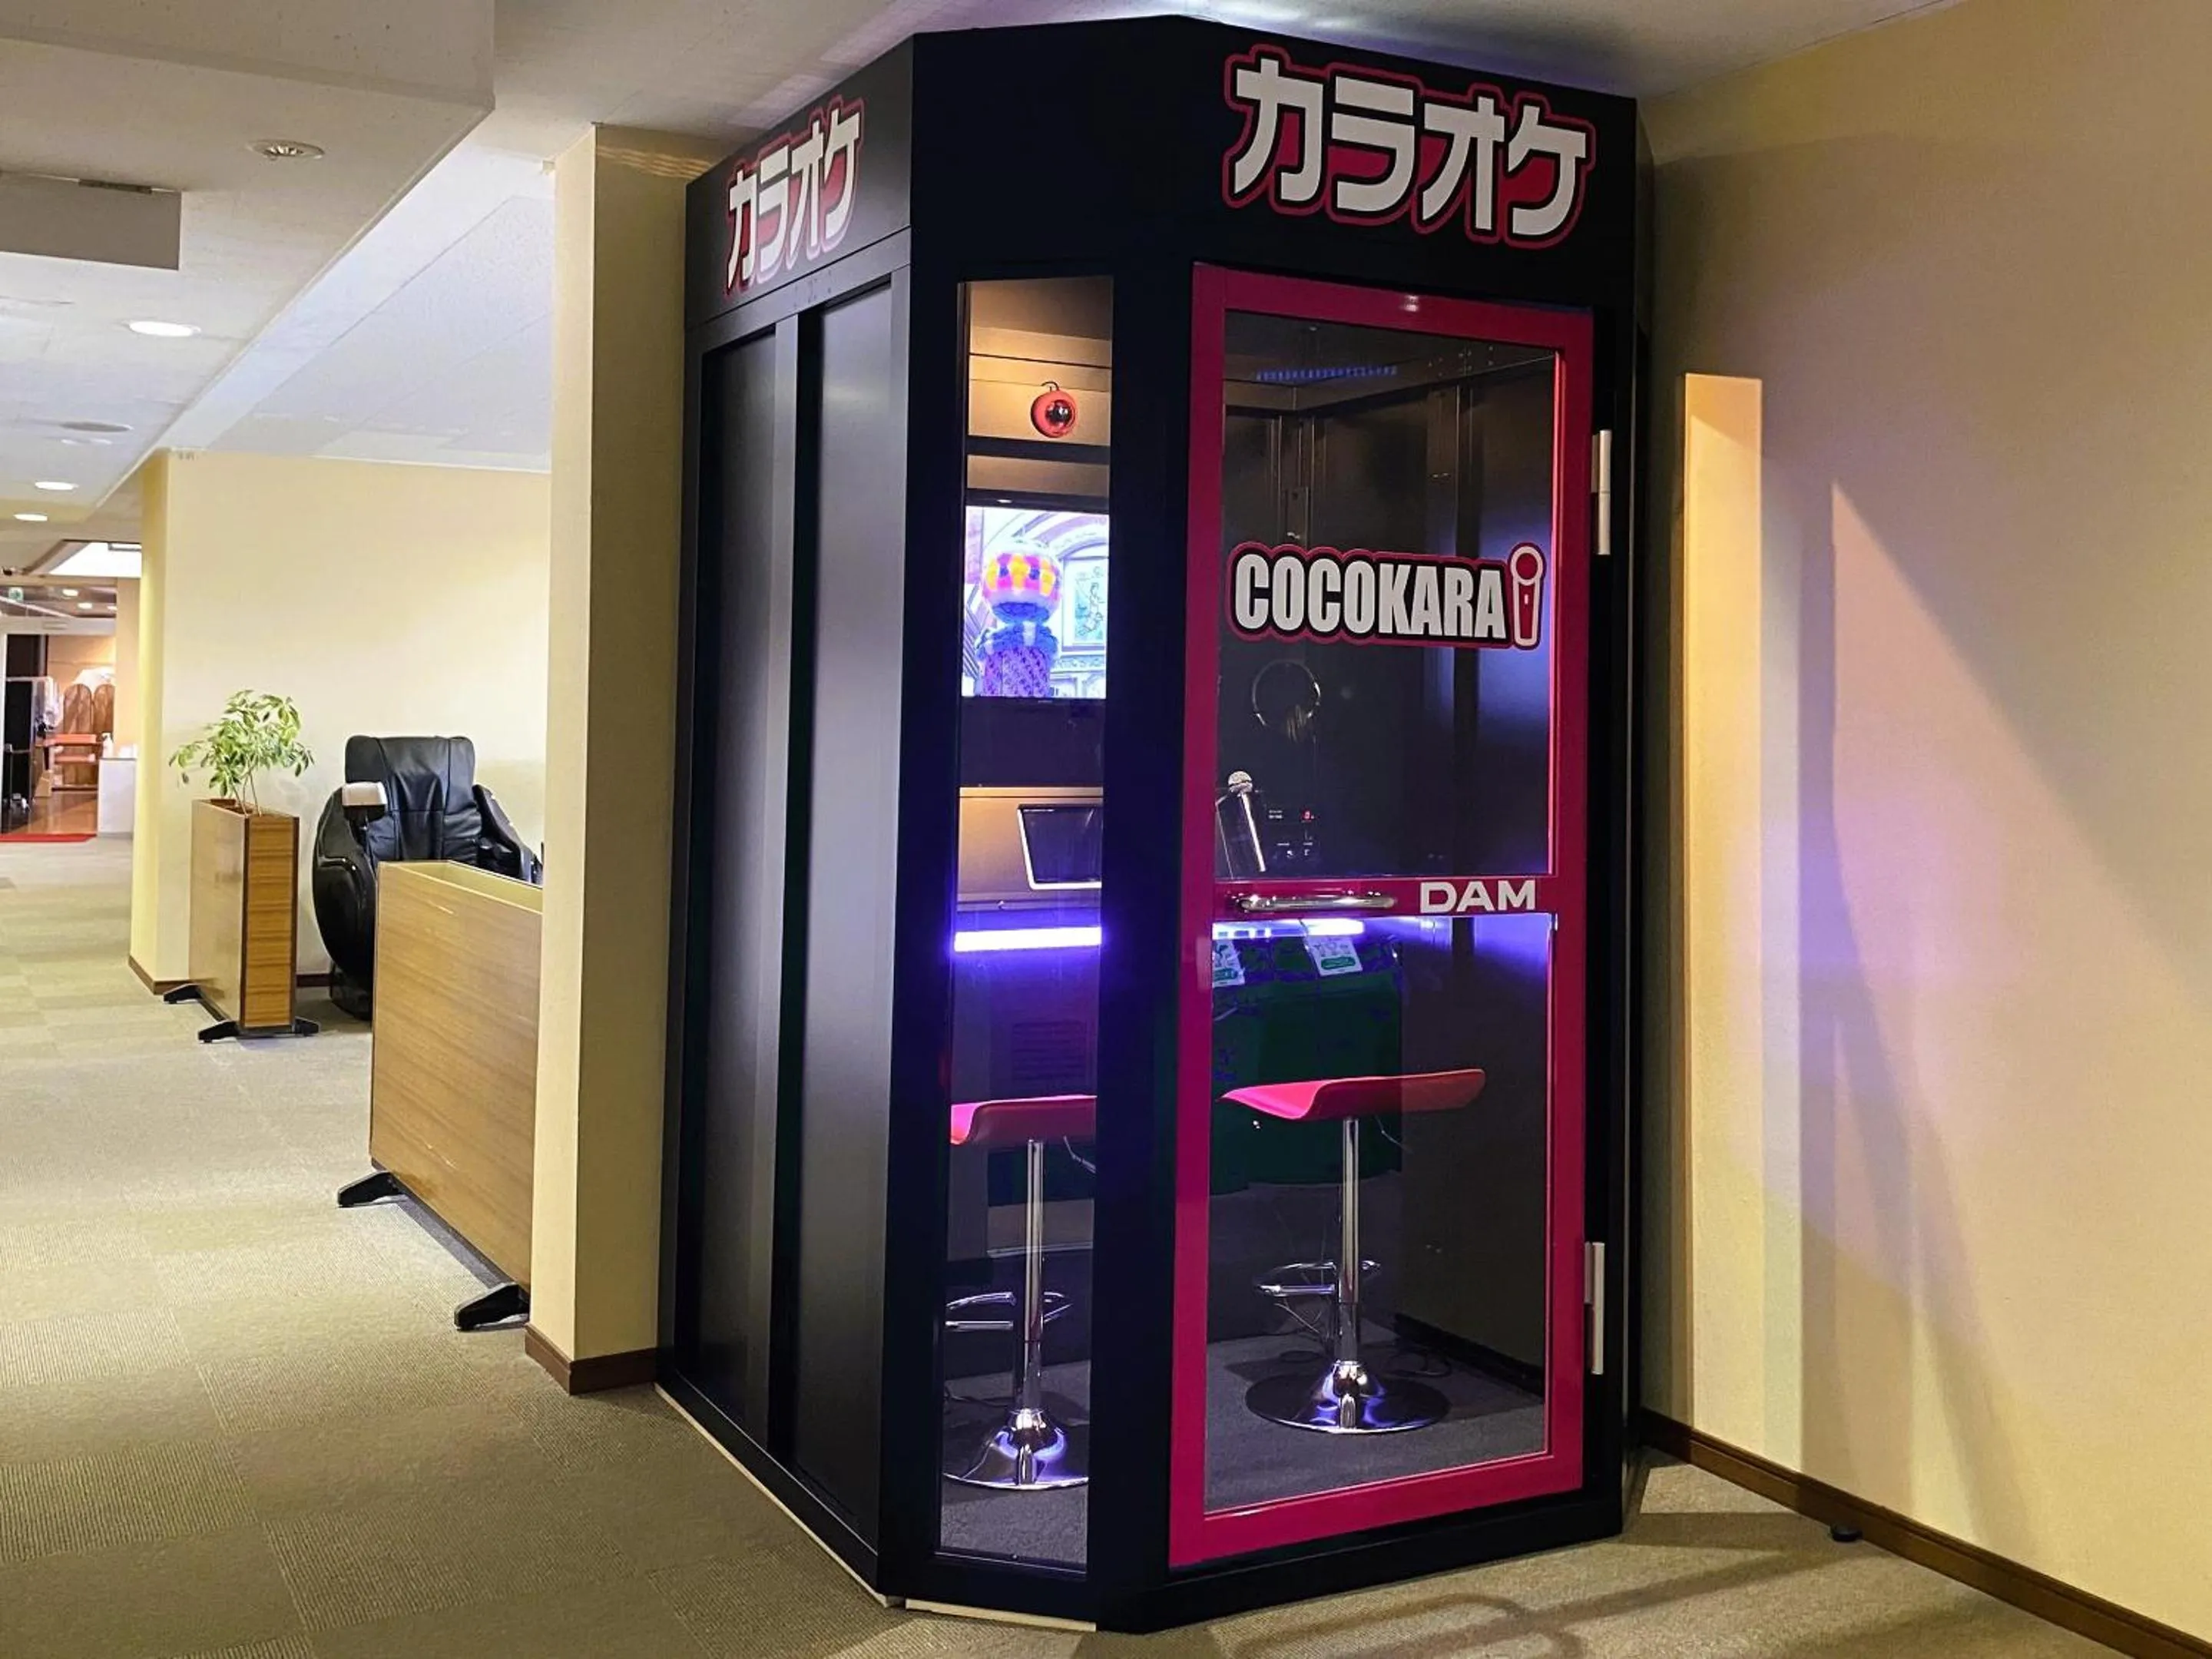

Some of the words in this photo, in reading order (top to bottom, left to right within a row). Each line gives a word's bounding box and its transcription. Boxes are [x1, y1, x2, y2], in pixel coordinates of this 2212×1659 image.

[727, 108, 860, 289] カラオケ
[1233, 58, 1588, 236] カラオケ
[1234, 553, 1507, 639] COCOKARA
[1419, 879, 1536, 914] DAM
